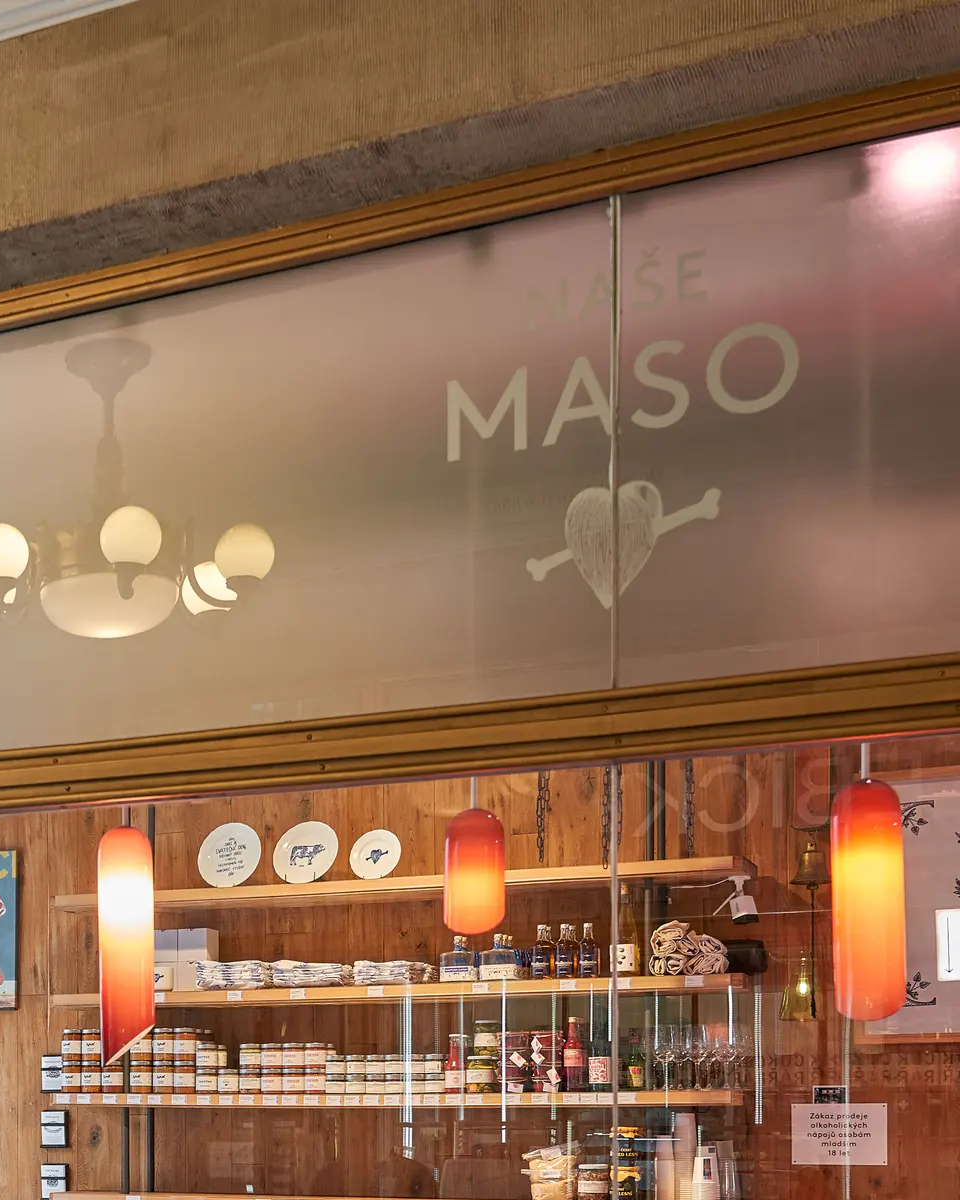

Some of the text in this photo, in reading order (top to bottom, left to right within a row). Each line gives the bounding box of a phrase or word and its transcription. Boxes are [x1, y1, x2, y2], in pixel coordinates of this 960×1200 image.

[526, 246, 708, 332] NAŠE
[446, 322, 800, 462] MASO
[810, 1112, 868, 1121] Zákaz prodeje
[810, 1121, 868, 1130] alkoholických
[807, 1131, 836, 1140] nápojů
